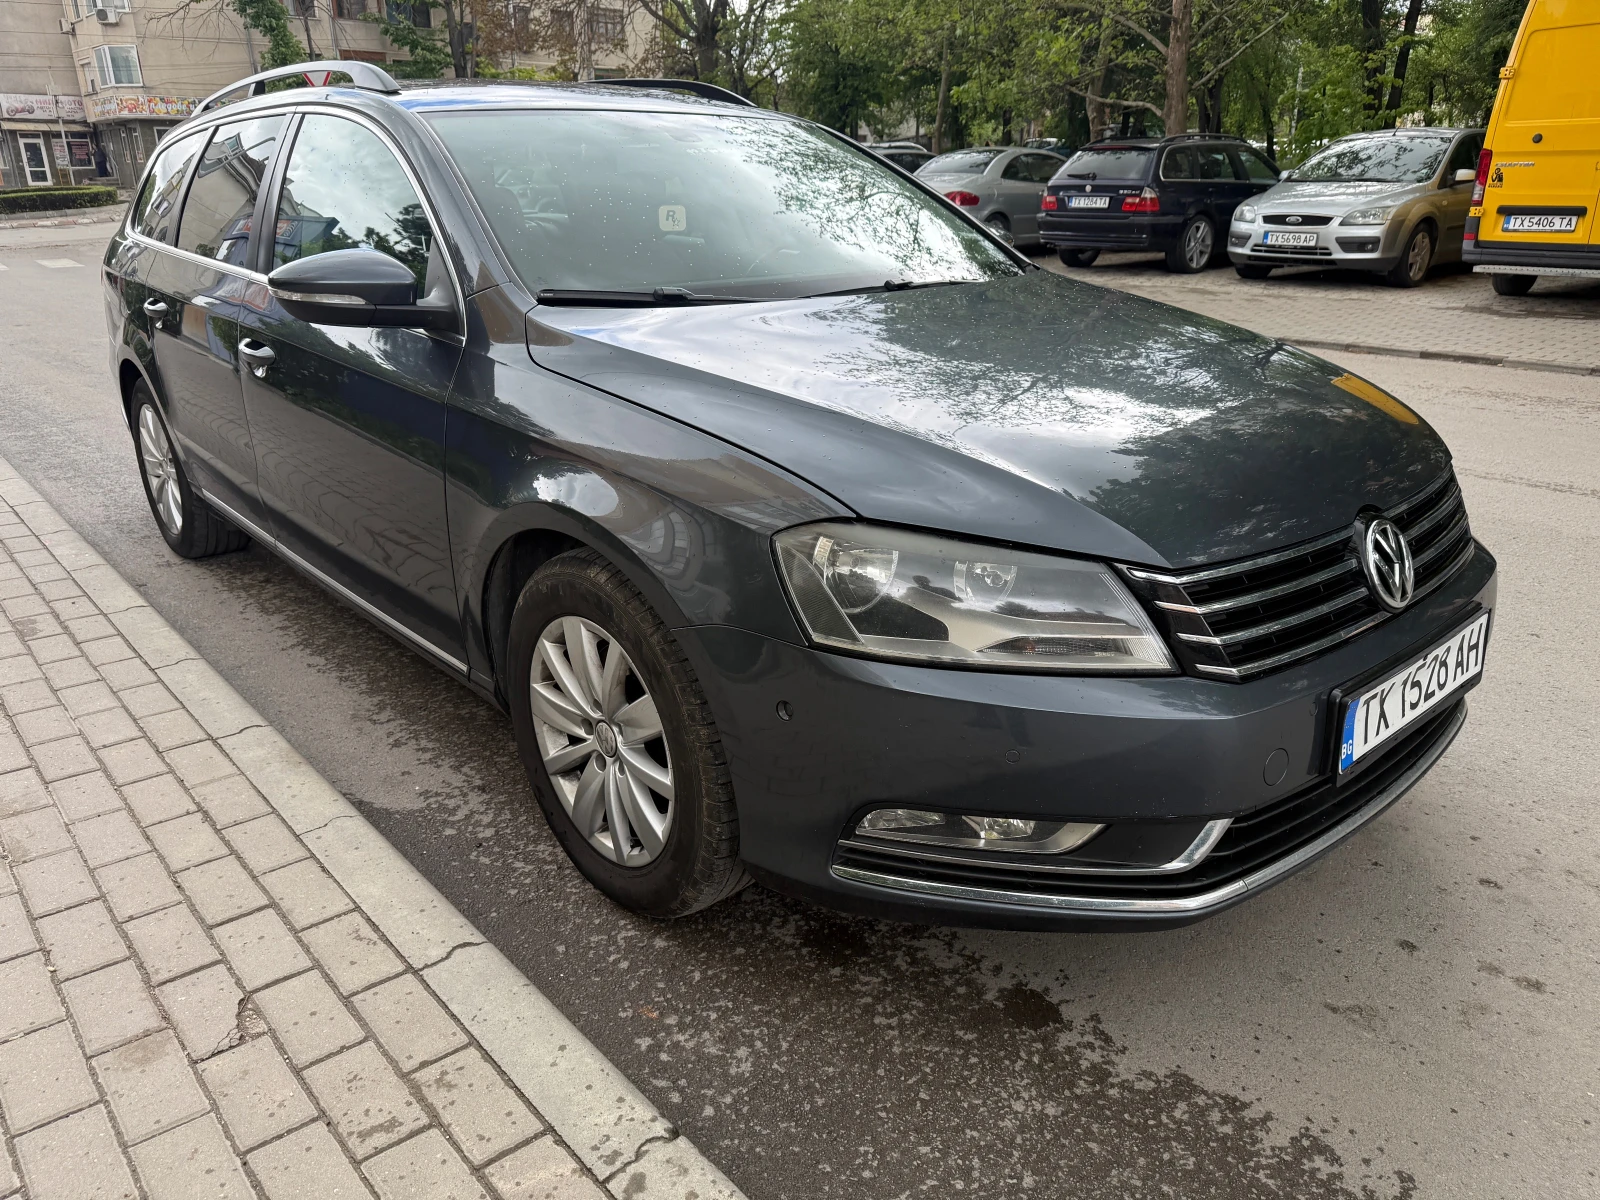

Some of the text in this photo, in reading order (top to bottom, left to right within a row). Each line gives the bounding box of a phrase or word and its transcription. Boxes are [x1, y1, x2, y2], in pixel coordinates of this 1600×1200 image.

[1073, 197, 1082, 206] TX
[1512, 216, 1573, 228] TX 5406 TA
[1269, 233, 1314, 245] TX 5698 AP
[1401, 645, 1451, 719] 1528
[1453, 623, 1483, 682] AH
[1341, 740, 1352, 760] BG
